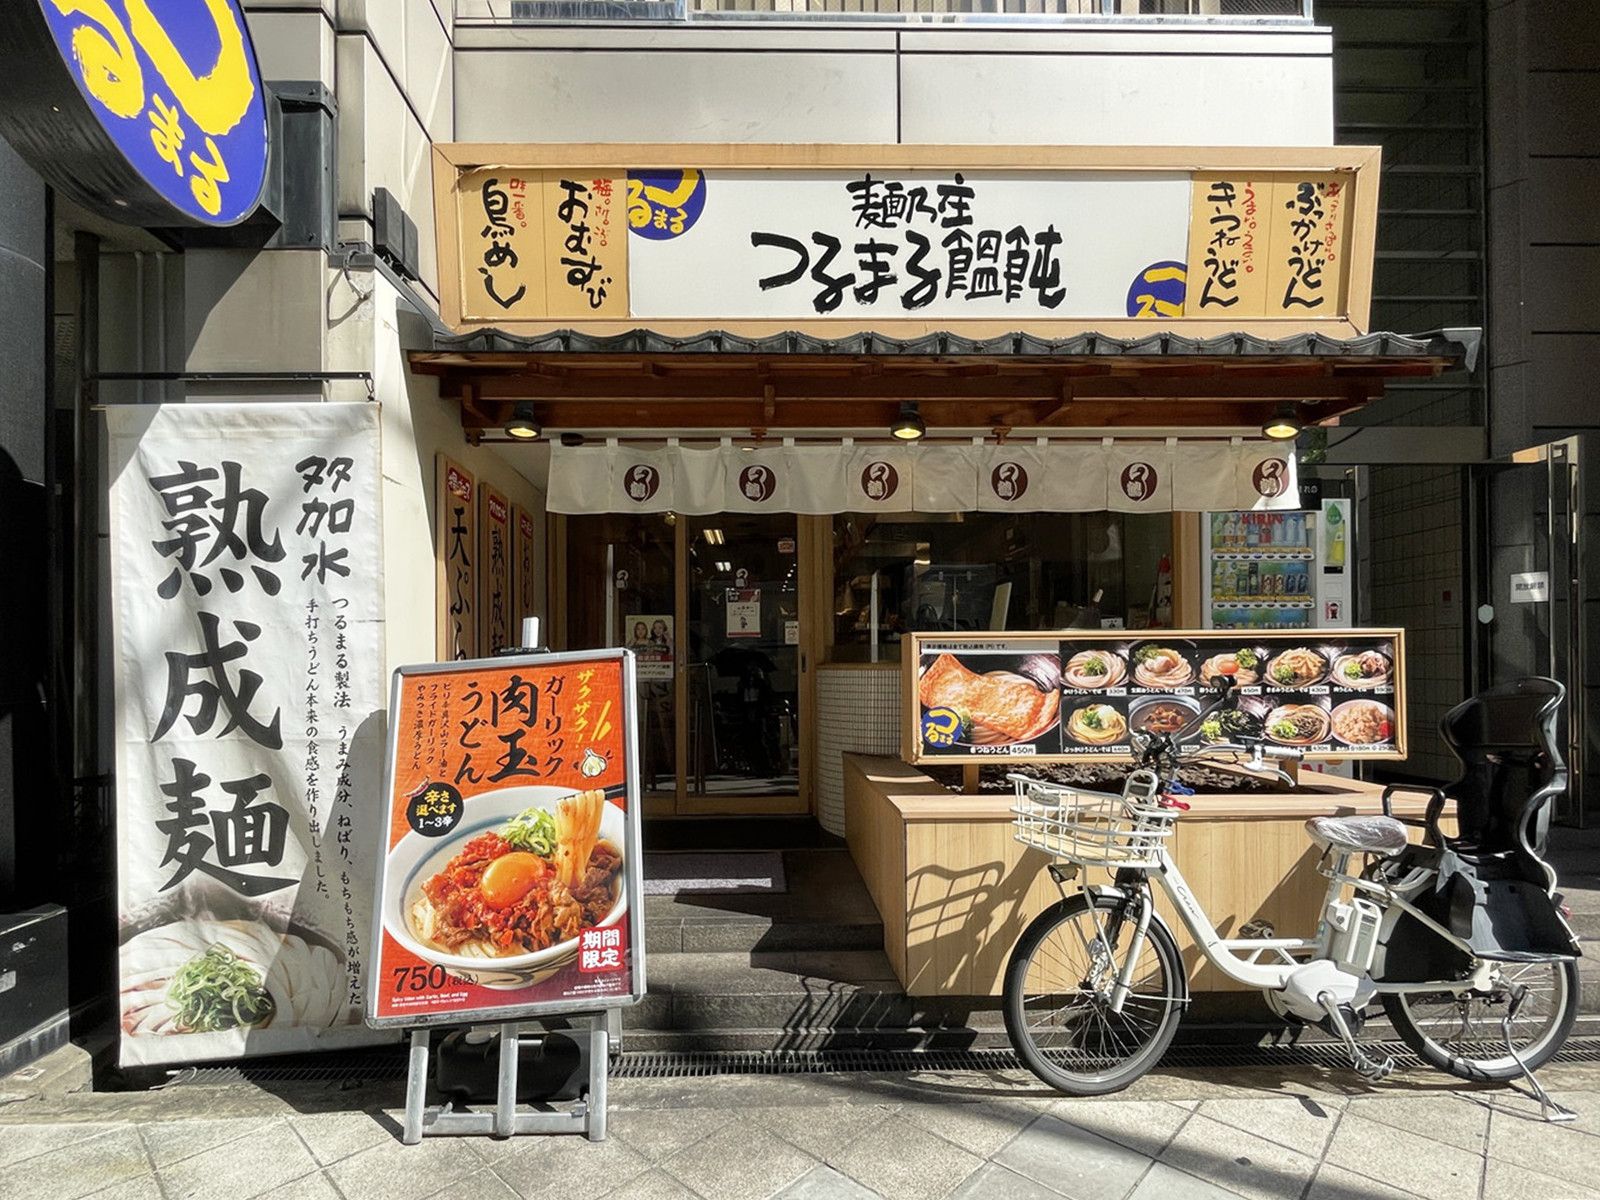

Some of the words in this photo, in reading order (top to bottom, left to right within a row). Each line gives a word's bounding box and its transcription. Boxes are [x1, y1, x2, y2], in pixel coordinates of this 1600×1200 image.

[477, 178, 526, 309] 鳥めし
[558, 179, 613, 309] おむすび
[750, 224, 1067, 314] つるまる饂飩
[1199, 181, 1241, 308] きつねうどん
[1282, 182, 1325, 309] ぶっかけうどん
[1242, 513, 1284, 526] KIRIN
[149, 461, 301, 898] 熟成麺
[332, 598, 352, 708] つるまる製法
[303, 598, 331, 900] 手打ちうどん本来の食感を作り出しました。
[411, 684, 427, 770] やみつき濃厚うどん
[426, 683, 439, 765] フライドガーリック
[453, 682, 489, 785] うどん
[487, 675, 541, 783] 肉玉
[545, 676, 565, 778] ガーリック
[416, 803, 457, 816] 選べます
[424, 790, 450, 805] 辛さ
[333, 725, 363, 1005] うまみ成分、ねばり、もちもち感が増えた
[582, 929, 621, 949] 期間
[582, 950, 621, 968] 限定
